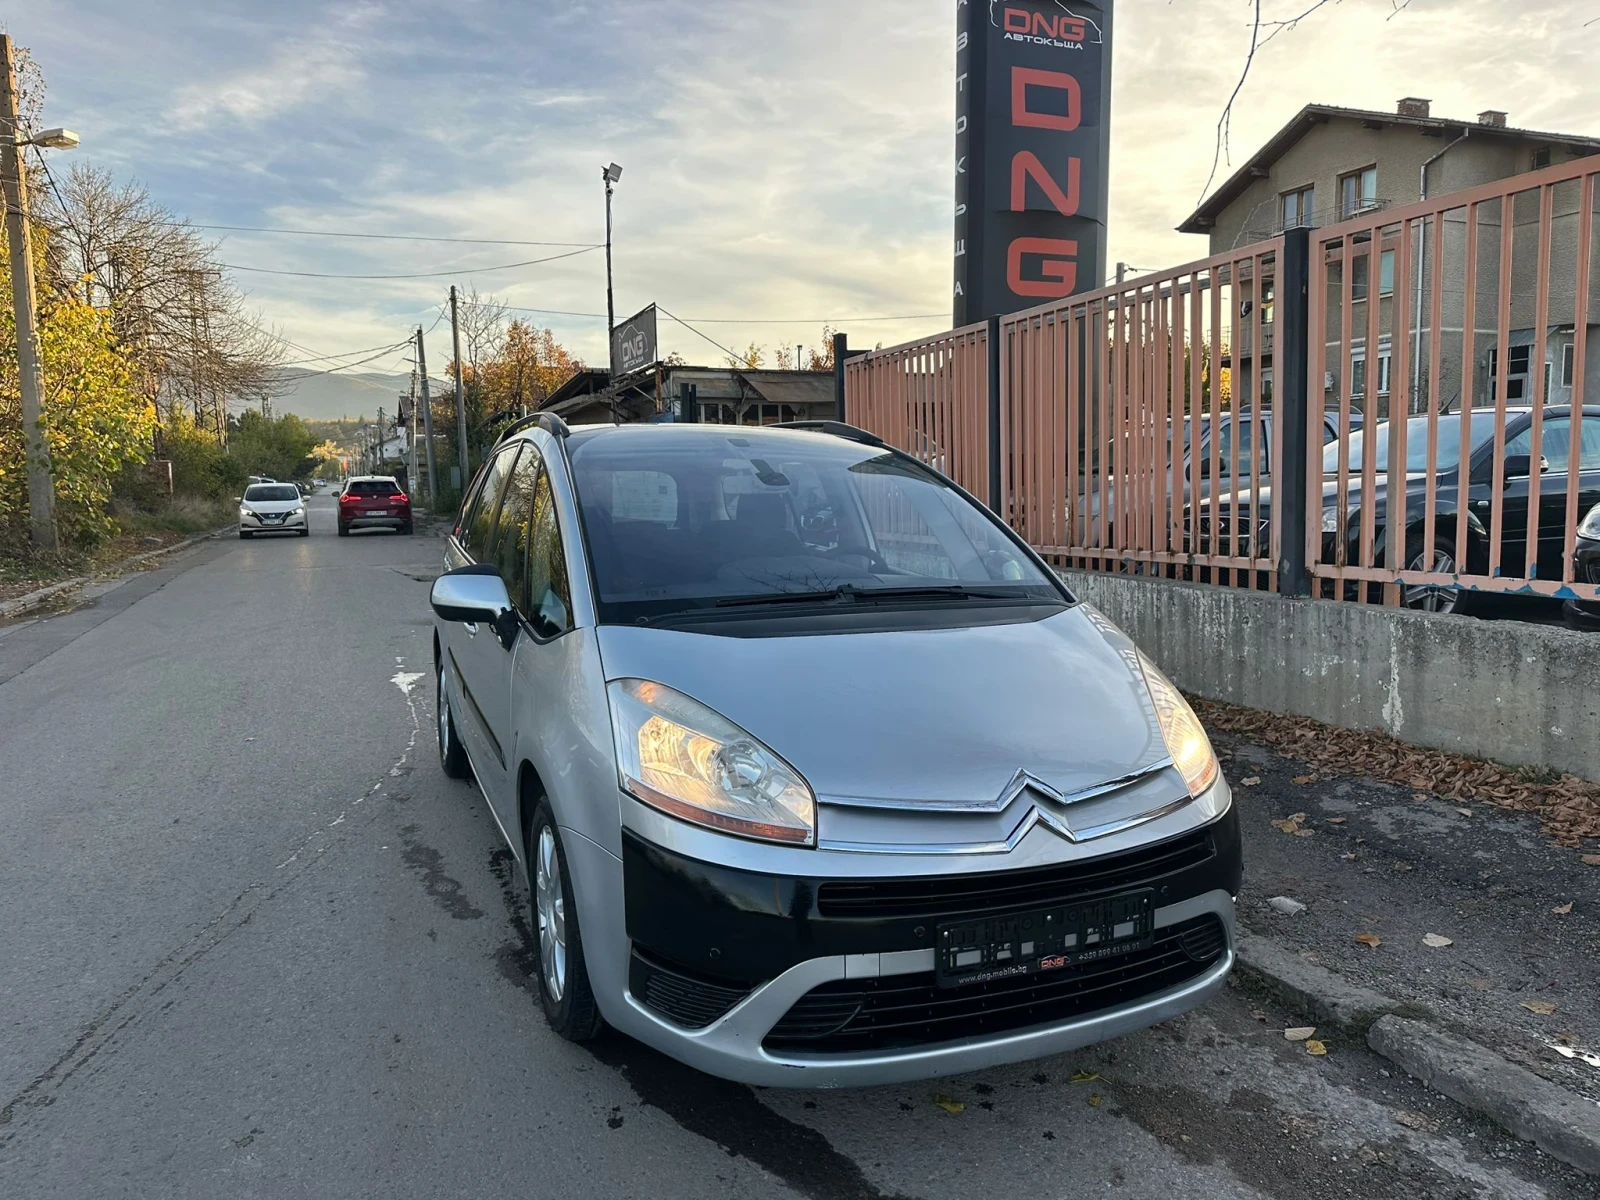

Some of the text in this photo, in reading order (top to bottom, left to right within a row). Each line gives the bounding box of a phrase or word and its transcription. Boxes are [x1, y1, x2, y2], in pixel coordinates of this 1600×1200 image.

[1004, 7, 1085, 41] DNG
[1003, 32, 1084, 50] АВТОКЪША
[1006, 65, 1082, 298] DNG
[622, 334, 644, 362] DNG
[958, 964, 1027, 984] www.dng.mobile.bg
[1078, 951, 1097, 961] +359
